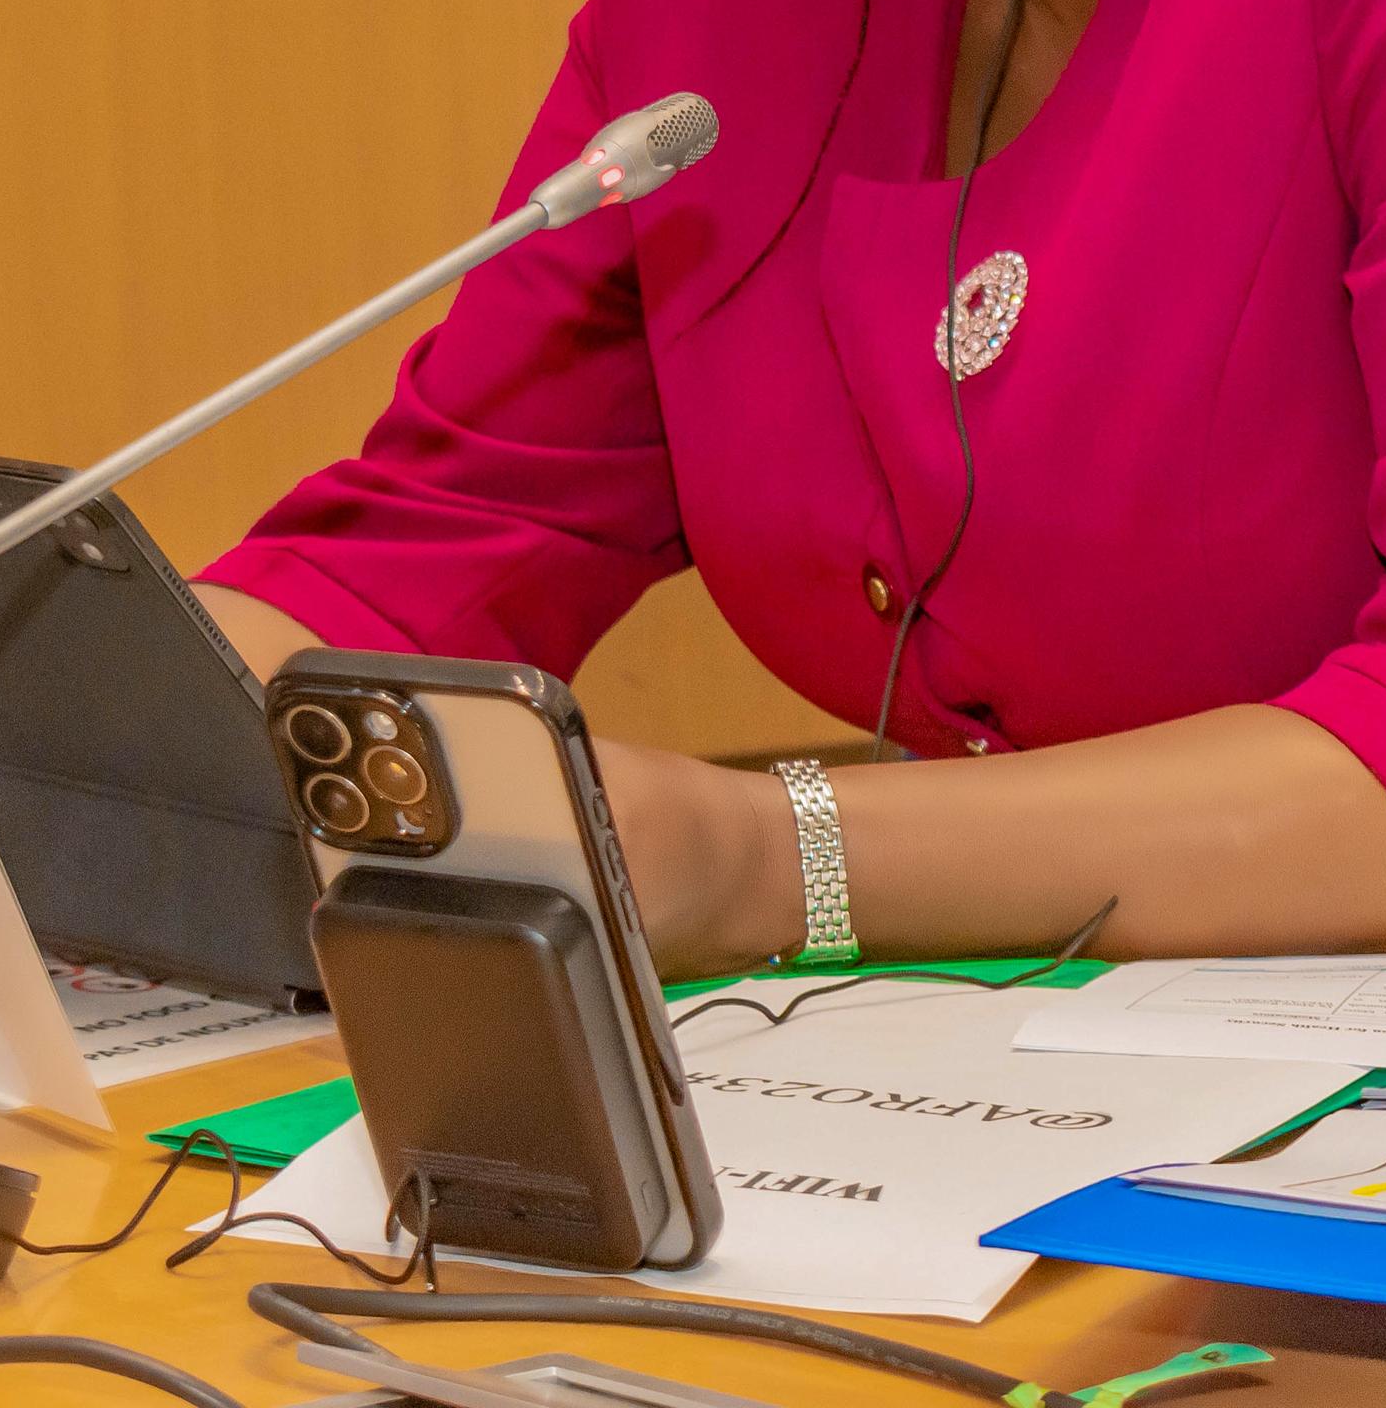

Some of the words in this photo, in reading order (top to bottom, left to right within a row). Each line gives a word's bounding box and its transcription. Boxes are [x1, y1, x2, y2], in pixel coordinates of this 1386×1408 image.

[74, 1018, 127, 1034] NO
[126, 1000, 210, 1023] FOOD
[83, 1045, 140, 1062] PAS
[135, 1034, 184, 1048] DE
